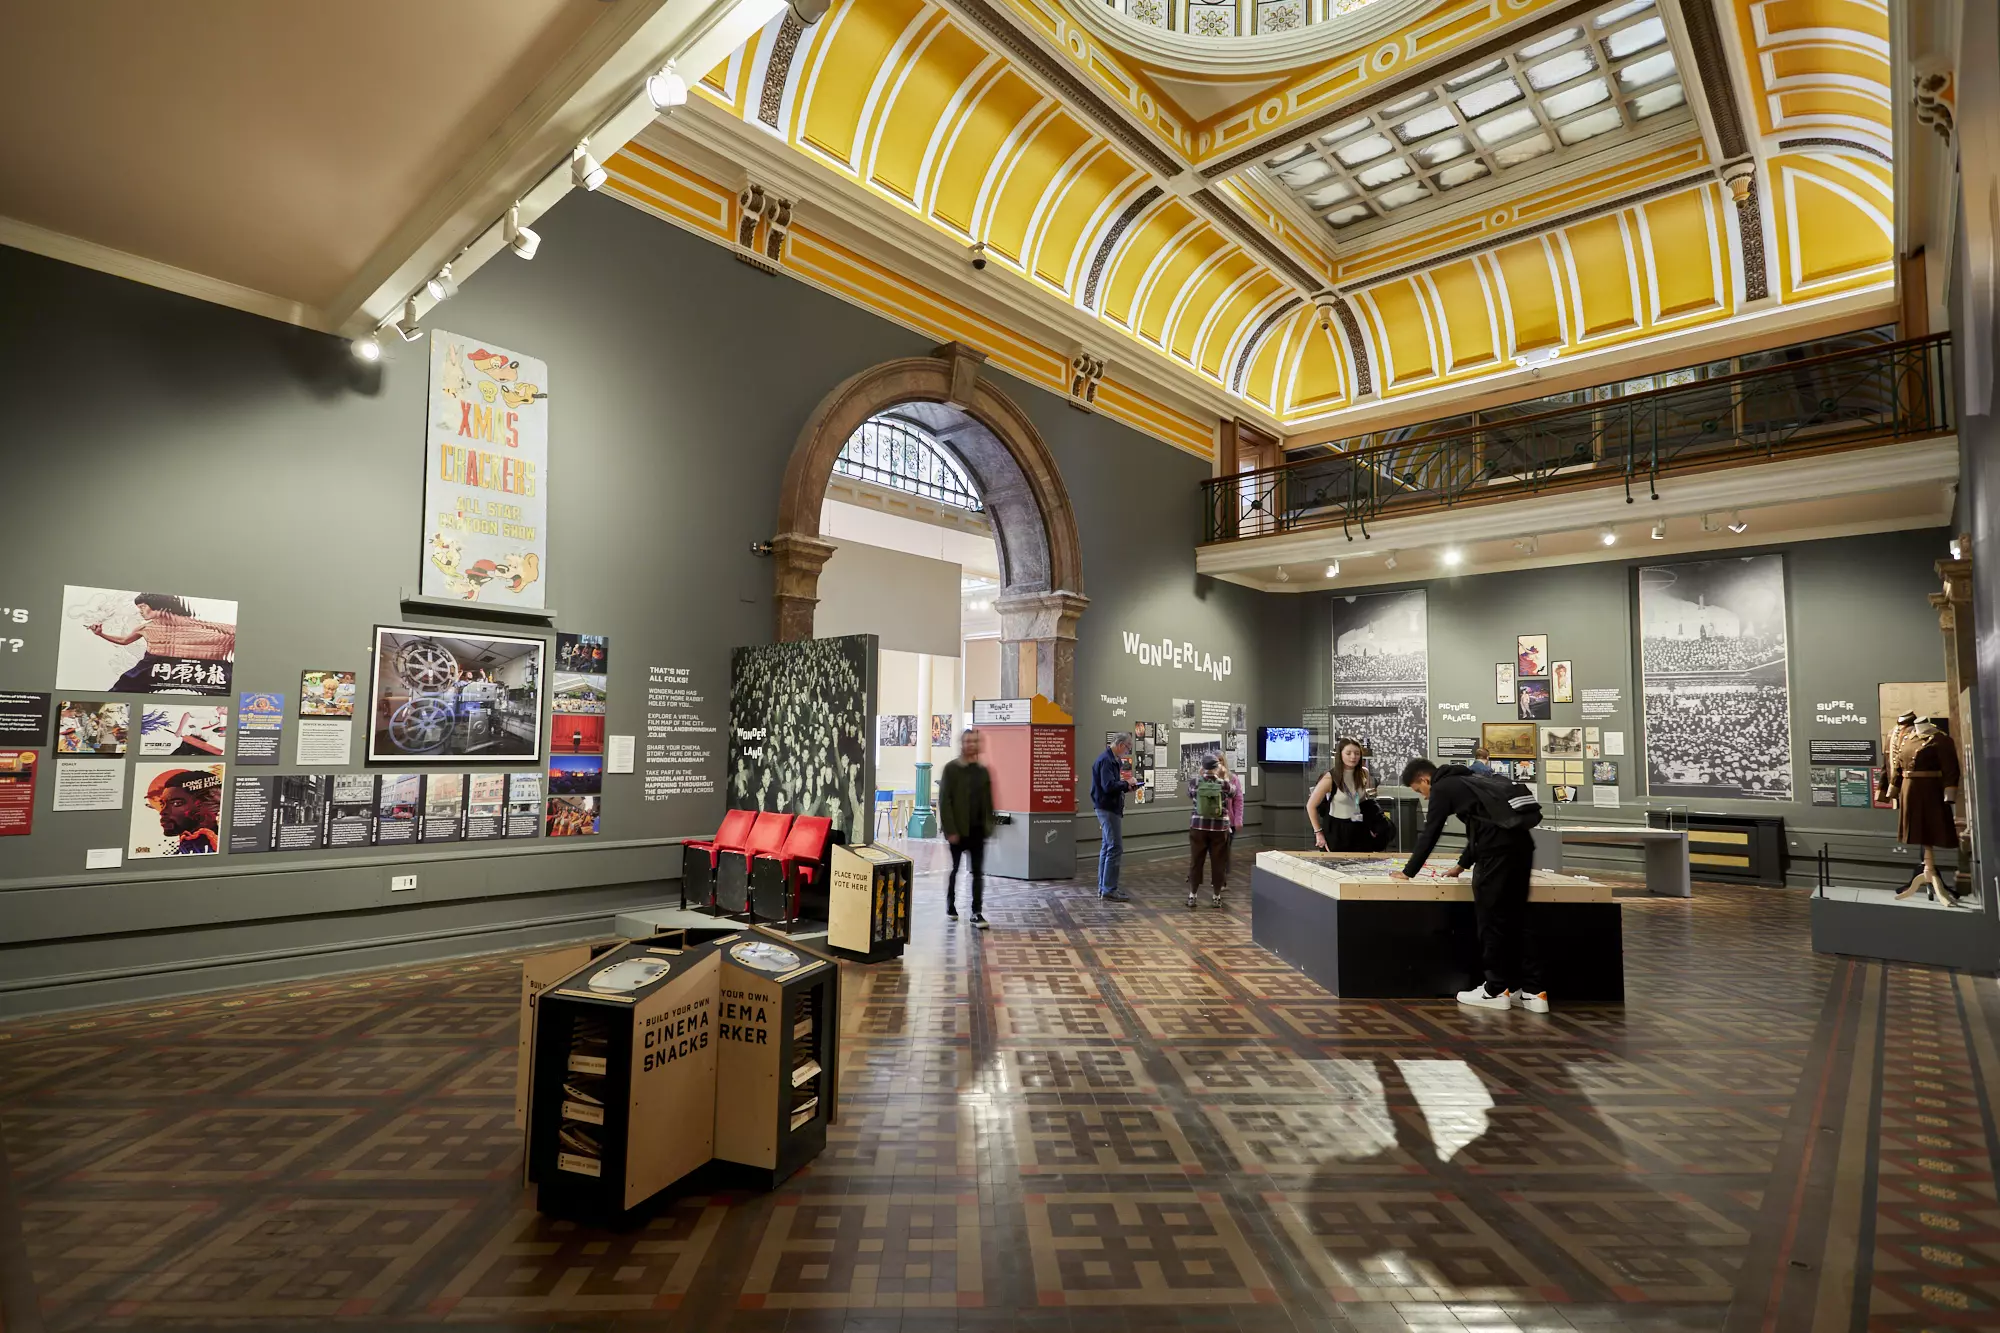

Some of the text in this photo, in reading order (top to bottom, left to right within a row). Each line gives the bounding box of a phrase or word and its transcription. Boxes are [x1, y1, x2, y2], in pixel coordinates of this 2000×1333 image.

[458, 400, 518, 448] XMAS
[441, 444, 535, 497] CRACKERS
[456, 497, 521, 520] ALL STAR
[503, 523, 535, 541] SHOW
[1123, 631, 1231, 681] WONDERLAND
[650, 667, 674, 675] THAT'S
[989, 703, 1013, 711] WONDER
[1438, 703, 1470, 711] PICTURE
[1816, 701, 1854, 711] SUPER
[1113, 708, 1126, 717] LIGHT
[1442, 713, 1476, 722] PALACES
[1816, 714, 1867, 725] CINEMAS
[737, 727, 766, 740] WONDER
[743, 746, 762, 759] LAND
[182, 778, 202, 788] LONG
[204, 780, 222, 788] KING
[834, 870, 868, 881] PLACE YOUR
[834, 881, 868, 892] VOTE HERE
[721, 989, 768, 1002] YOUR OWN
[646, 997, 710, 1027] BUILD YOUR OWN
[644, 1011, 709, 1049] CINEMA
[643, 1032, 709, 1072] SNACKS
